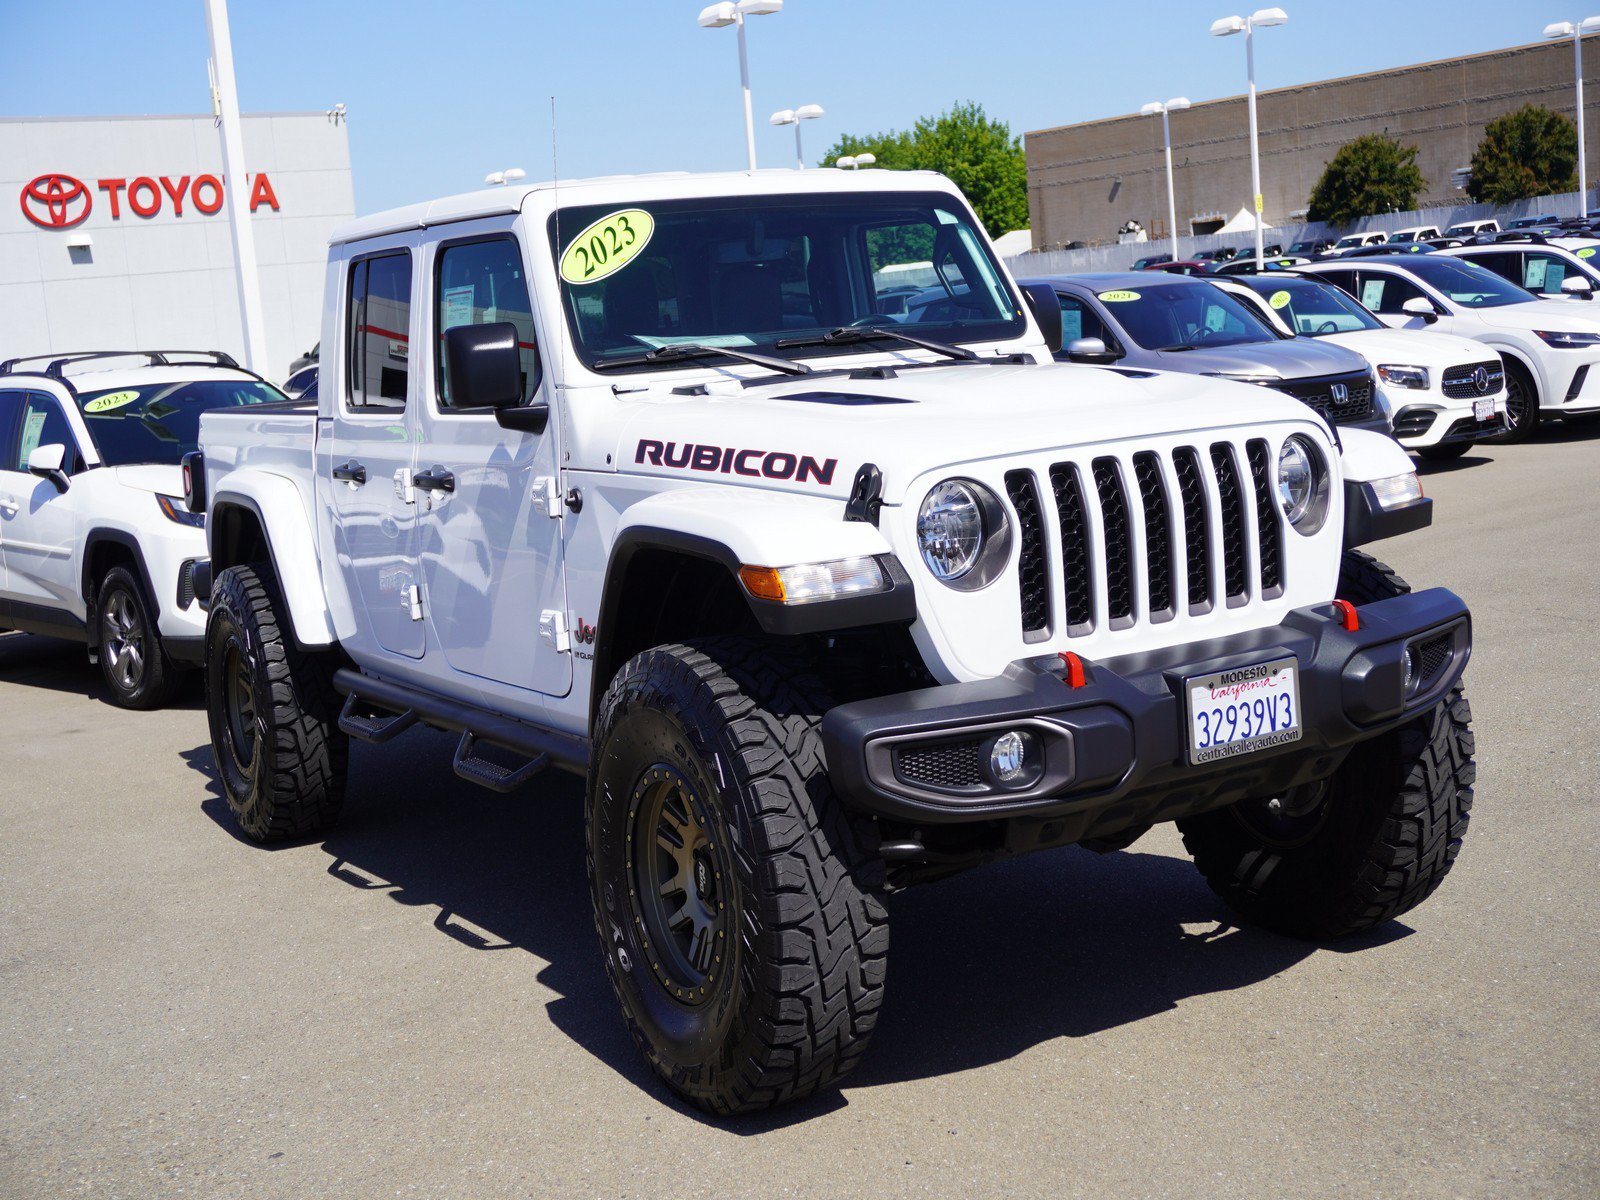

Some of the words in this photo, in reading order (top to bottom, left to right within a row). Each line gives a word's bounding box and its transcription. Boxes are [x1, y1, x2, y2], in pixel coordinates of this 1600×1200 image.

[98, 173, 280, 217] TOYOA
[575, 216, 635, 277] 2023
[95, 393, 129, 409] 2023
[634, 438, 838, 486] RUBICON
[1211, 677, 1277, 700] California
[1220, 666, 1267, 684] MODESTO
[1197, 693, 1292, 748] 32939V3
[1197, 730, 1298, 762] centralvalleyauto.com
